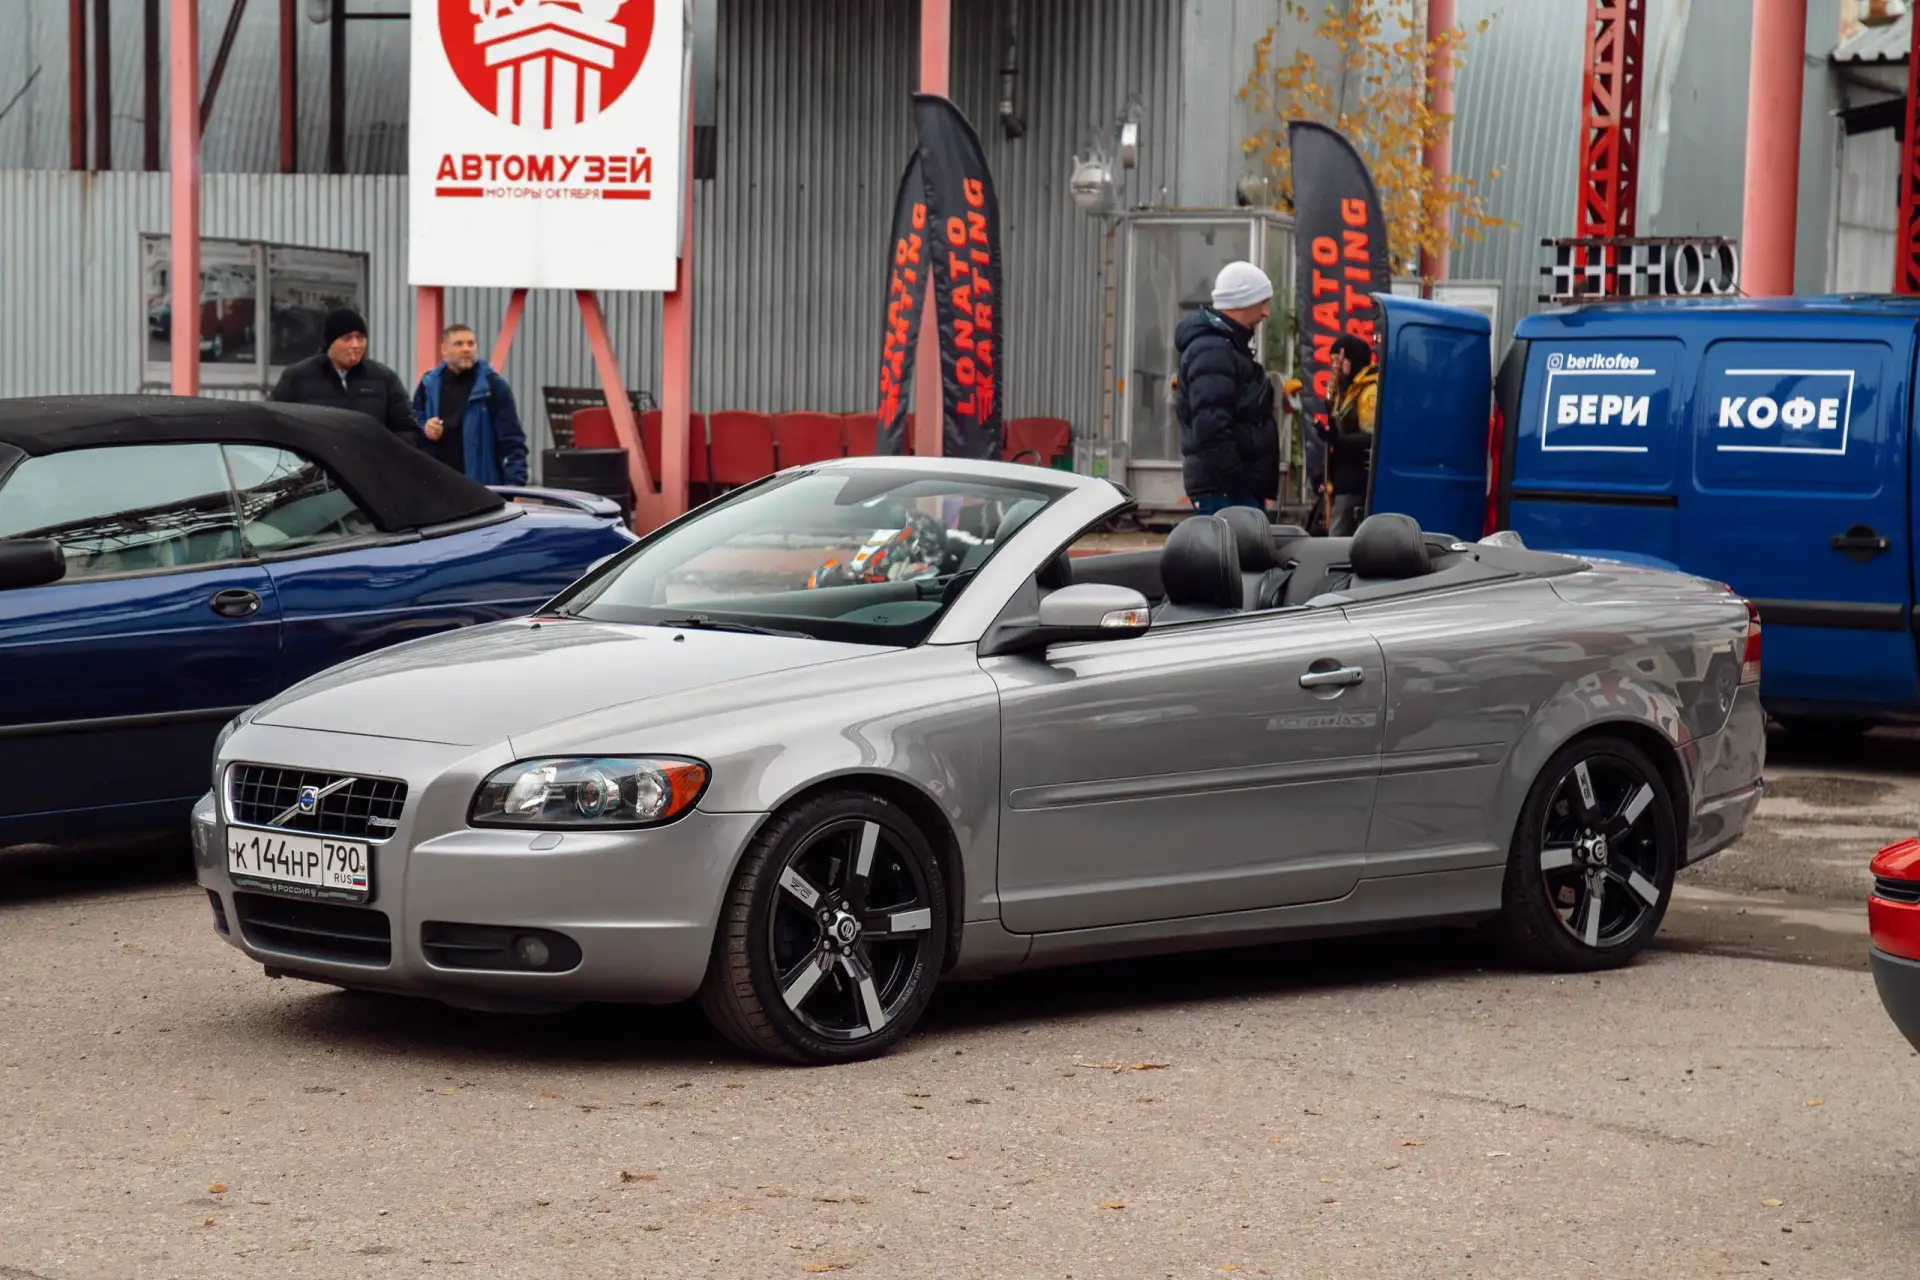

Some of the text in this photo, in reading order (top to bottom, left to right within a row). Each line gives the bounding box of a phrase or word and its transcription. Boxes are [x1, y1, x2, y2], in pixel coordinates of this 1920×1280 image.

[435, 147, 653, 184] АВТОМУЗЕЙ
[486, 187, 600, 200] МОТОРЫ ОКТЯБРЯ
[1341, 198, 1377, 365] RTING
[946, 216, 976, 415] LONATO
[963, 177, 995, 424] KARTING
[1566, 352, 1640, 369] berikofee
[1556, 394, 1841, 430] БЕРИ КОФЕ
[323, 843, 360, 873] 790
[277, 883, 311, 897] РОССИЯ
[334, 873, 353, 885] RUS
